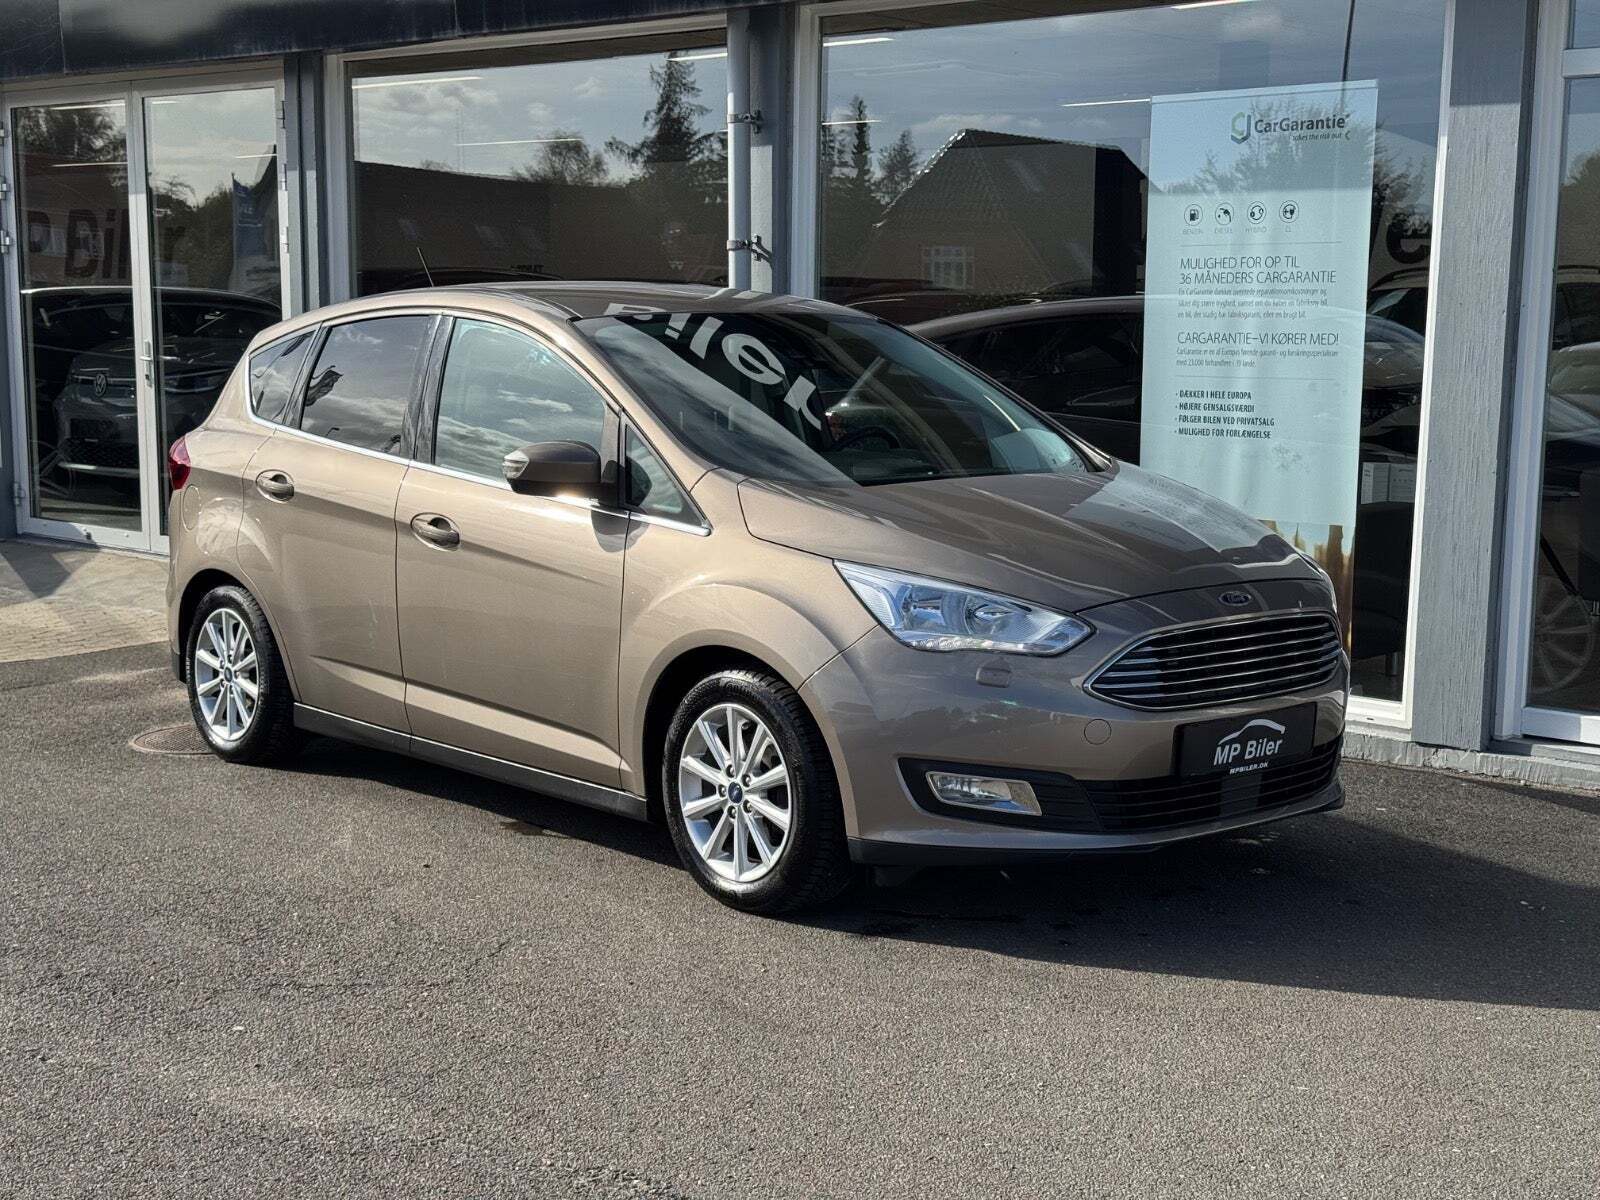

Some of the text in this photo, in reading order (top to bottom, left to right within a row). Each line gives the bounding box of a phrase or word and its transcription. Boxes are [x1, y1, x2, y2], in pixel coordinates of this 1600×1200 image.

[1255, 115, 1346, 134] CarGarantie
[1180, 255, 1300, 270] MULIGHED FOR OP TIL
[1179, 270, 1337, 285] 36 MÅNEDERS CARGARANTIE
[1271, 332, 1307, 345] KØRER
[1309, 332, 1339, 346] MED!
[1179, 389, 1205, 399] DÆKKER
[1210, 390, 1226, 400] HELE
[1227, 391, 1252, 401] EUROPA
[1179, 402, 1255, 413] HØJERE GENSALGSVÆRDI
[1178, 414, 1275, 427] FØLGER BILEN VED PRIVATSALG
[1178, 427, 1272, 439] MULIGHED FOR FORLÆNGELSE
[1213, 737, 1284, 766] MP Biler
[1229, 761, 1269, 775] MPBILER.DK
